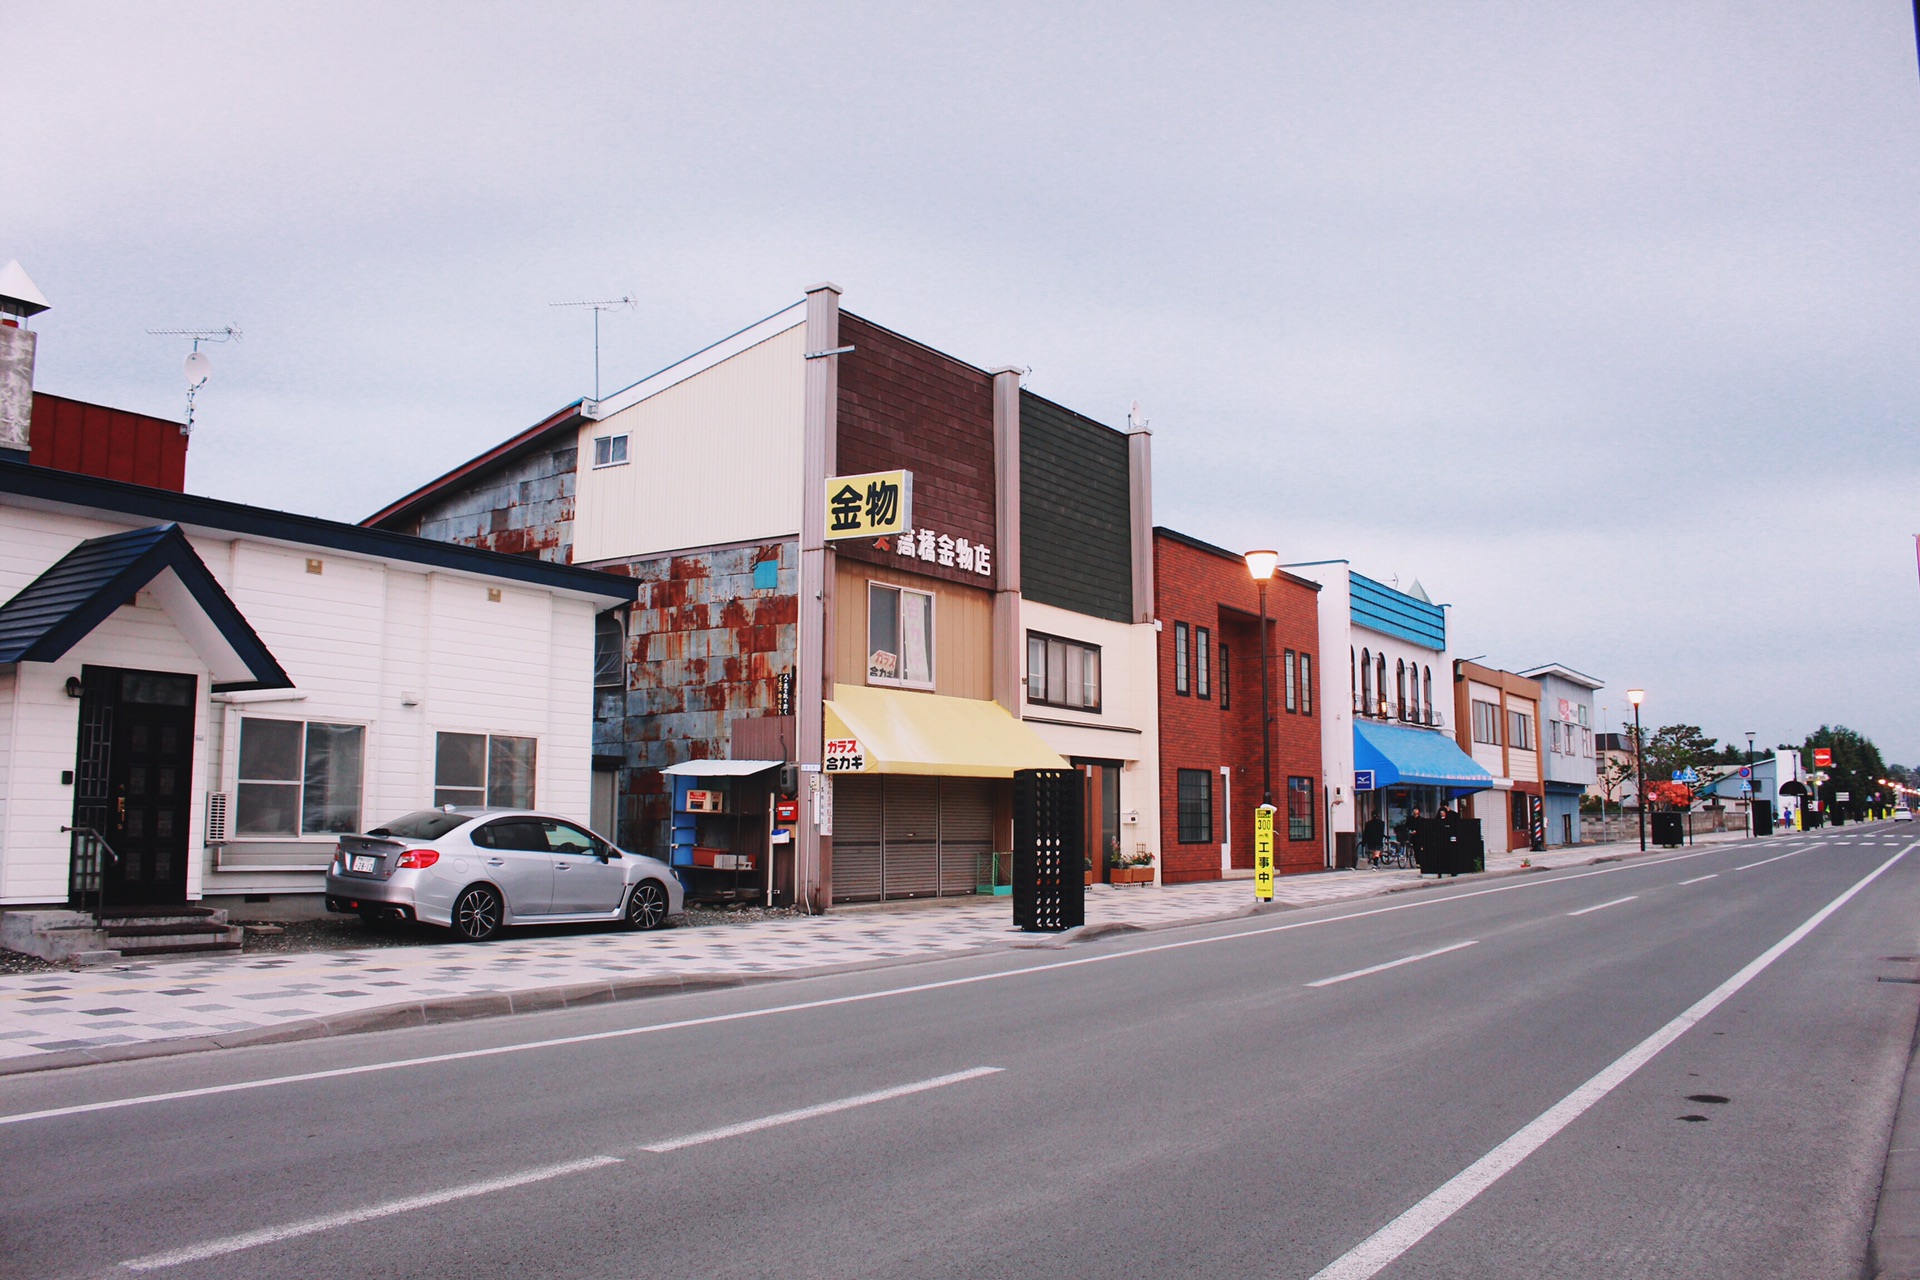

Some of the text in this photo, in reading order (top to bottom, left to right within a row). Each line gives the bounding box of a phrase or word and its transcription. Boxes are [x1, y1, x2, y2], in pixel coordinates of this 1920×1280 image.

[831, 480, 899, 531] 金物
[897, 528, 991, 576] 高橋金物店
[875, 651, 897, 667] ガラス
[827, 740, 857, 754] ガラス
[826, 754, 863, 770] 合カギ
[1257, 819, 1271, 830] 300
[1258, 842, 1270, 883] 工事中
